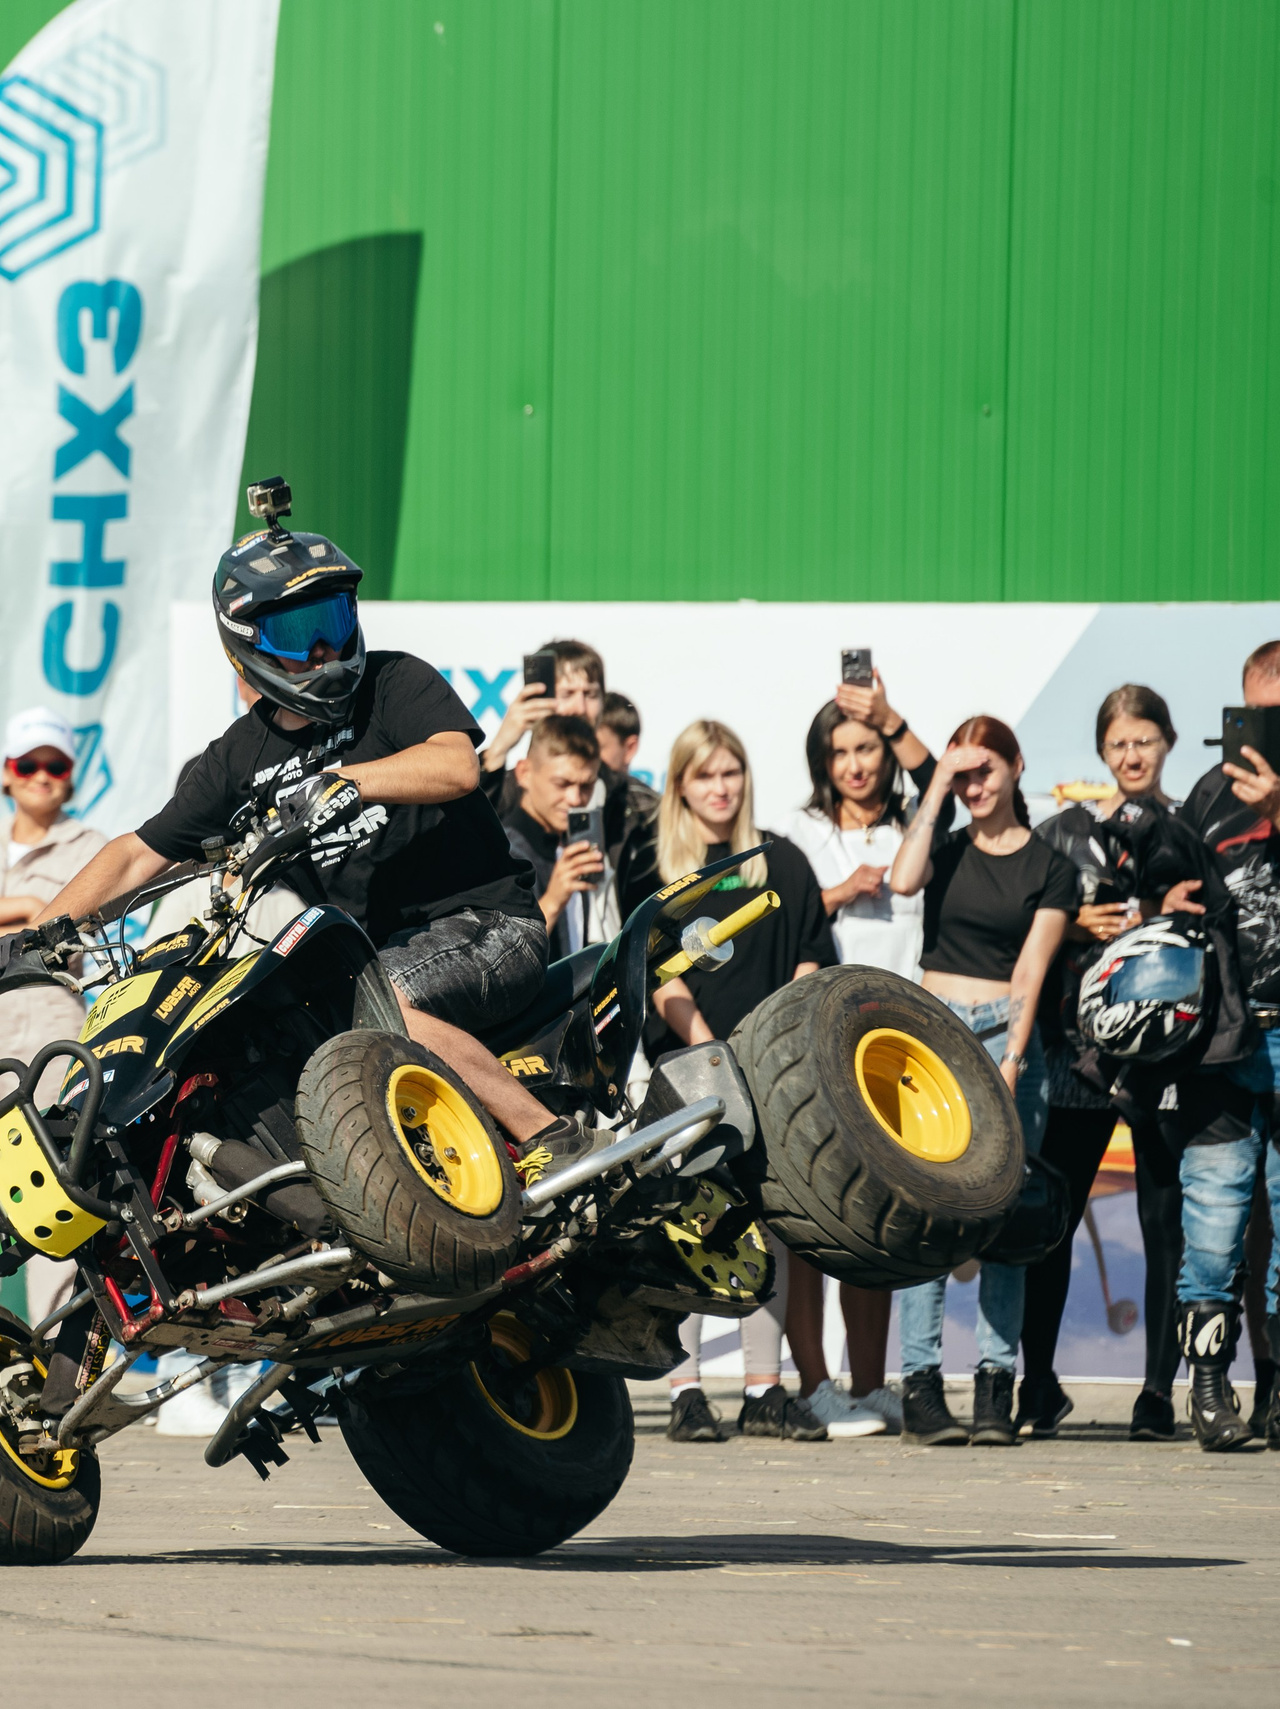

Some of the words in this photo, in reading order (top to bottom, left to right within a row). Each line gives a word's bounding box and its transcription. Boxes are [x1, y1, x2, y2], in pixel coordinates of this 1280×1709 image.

[656, 873, 702, 900] LUBSAR
[155, 975, 196, 1019] LUBSAR
[187, 982, 202, 998] MOTO
[80, 1355, 93, 1386] DRINK
